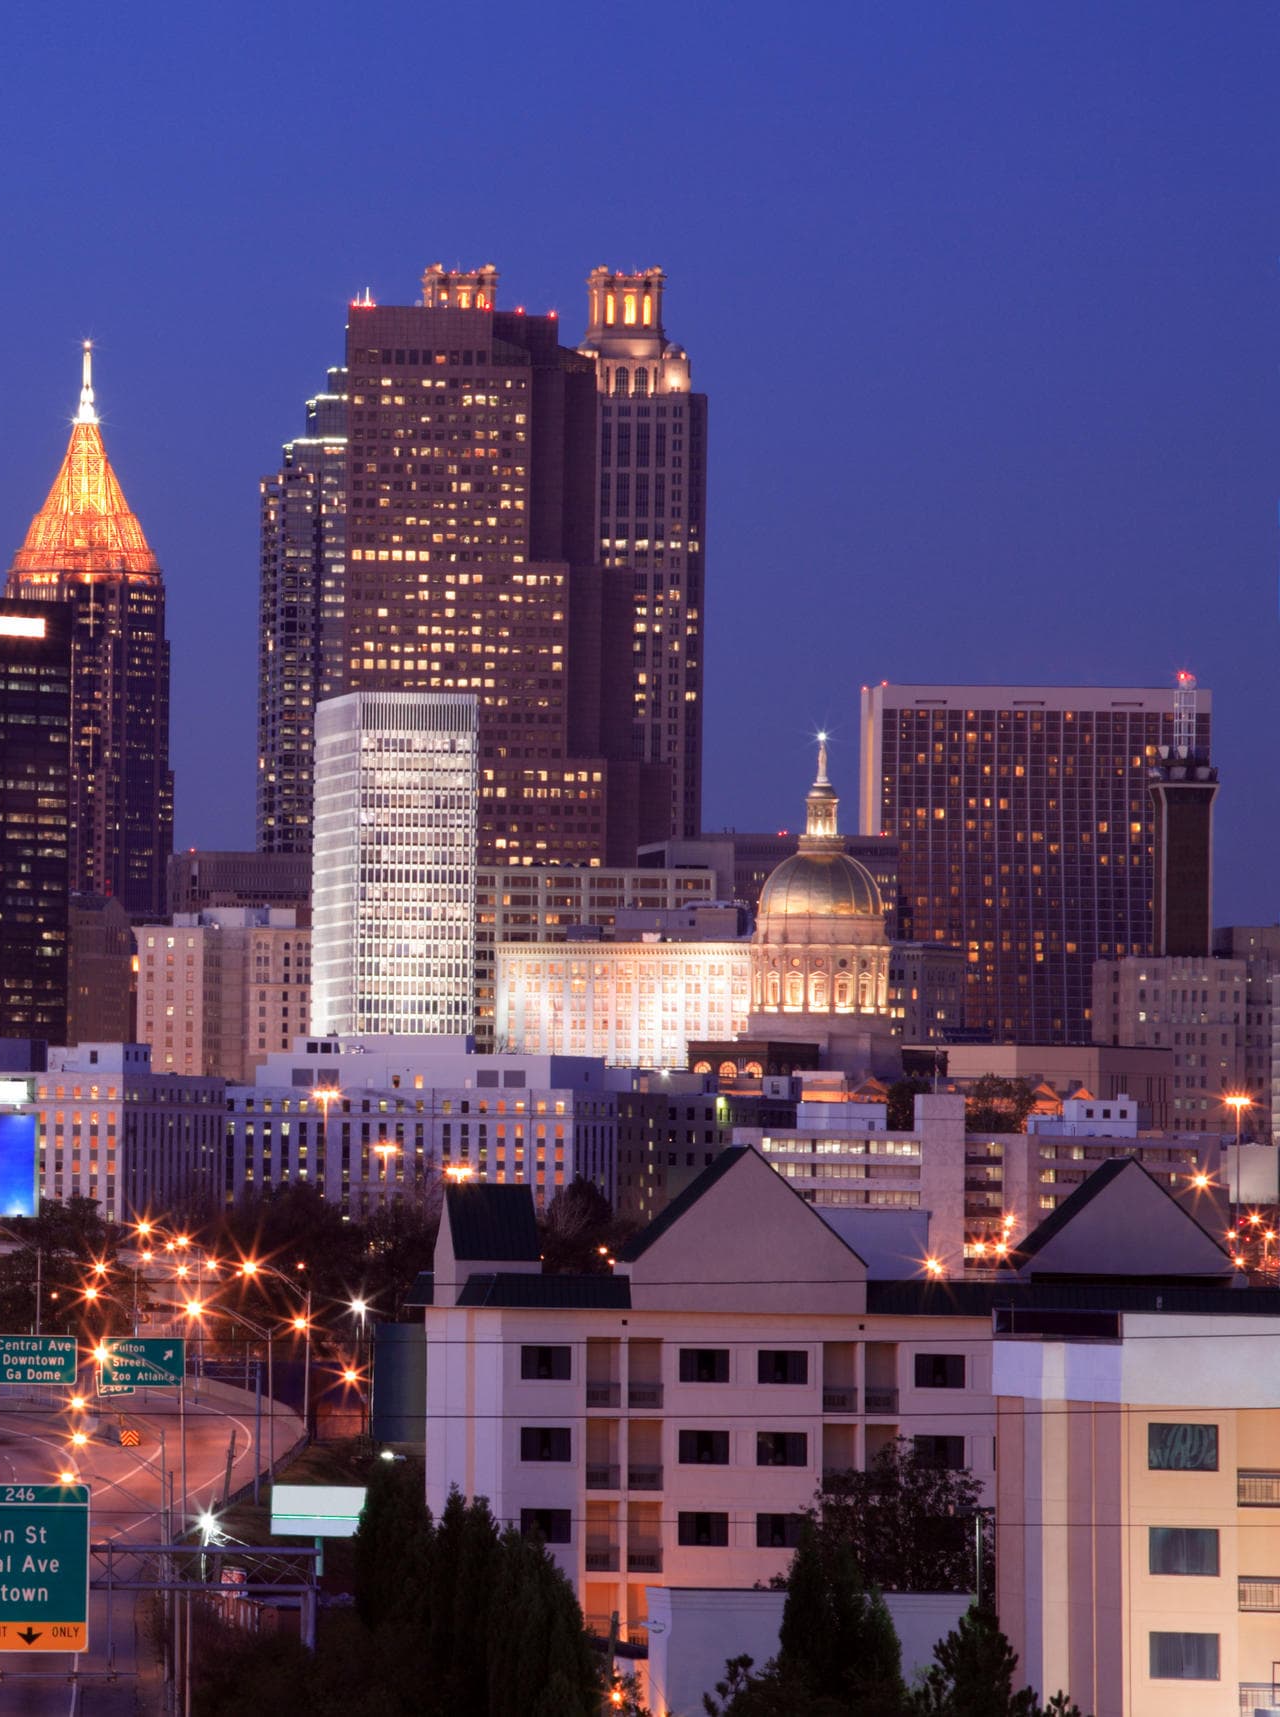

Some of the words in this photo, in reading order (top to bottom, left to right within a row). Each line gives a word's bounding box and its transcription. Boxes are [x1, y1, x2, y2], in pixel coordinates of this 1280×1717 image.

[48, 1340, 71, 1351] Ave
[112, 1343, 146, 1353] Fulton
[2, 1354, 65, 1366] Downtown
[113, 1358, 146, 1367] Street
[6, 1369, 22, 1381] Ga
[27, 1369, 61, 1381] Dome
[112, 1371, 131, 1381] Zoo
[137, 1371, 175, 1382] Atlanta
[5, 1488, 36, 1502] 246
[25, 1525, 47, 1544] St
[22, 1555, 60, 1573] Ave
[52, 1626, 80, 1638] ONLY
